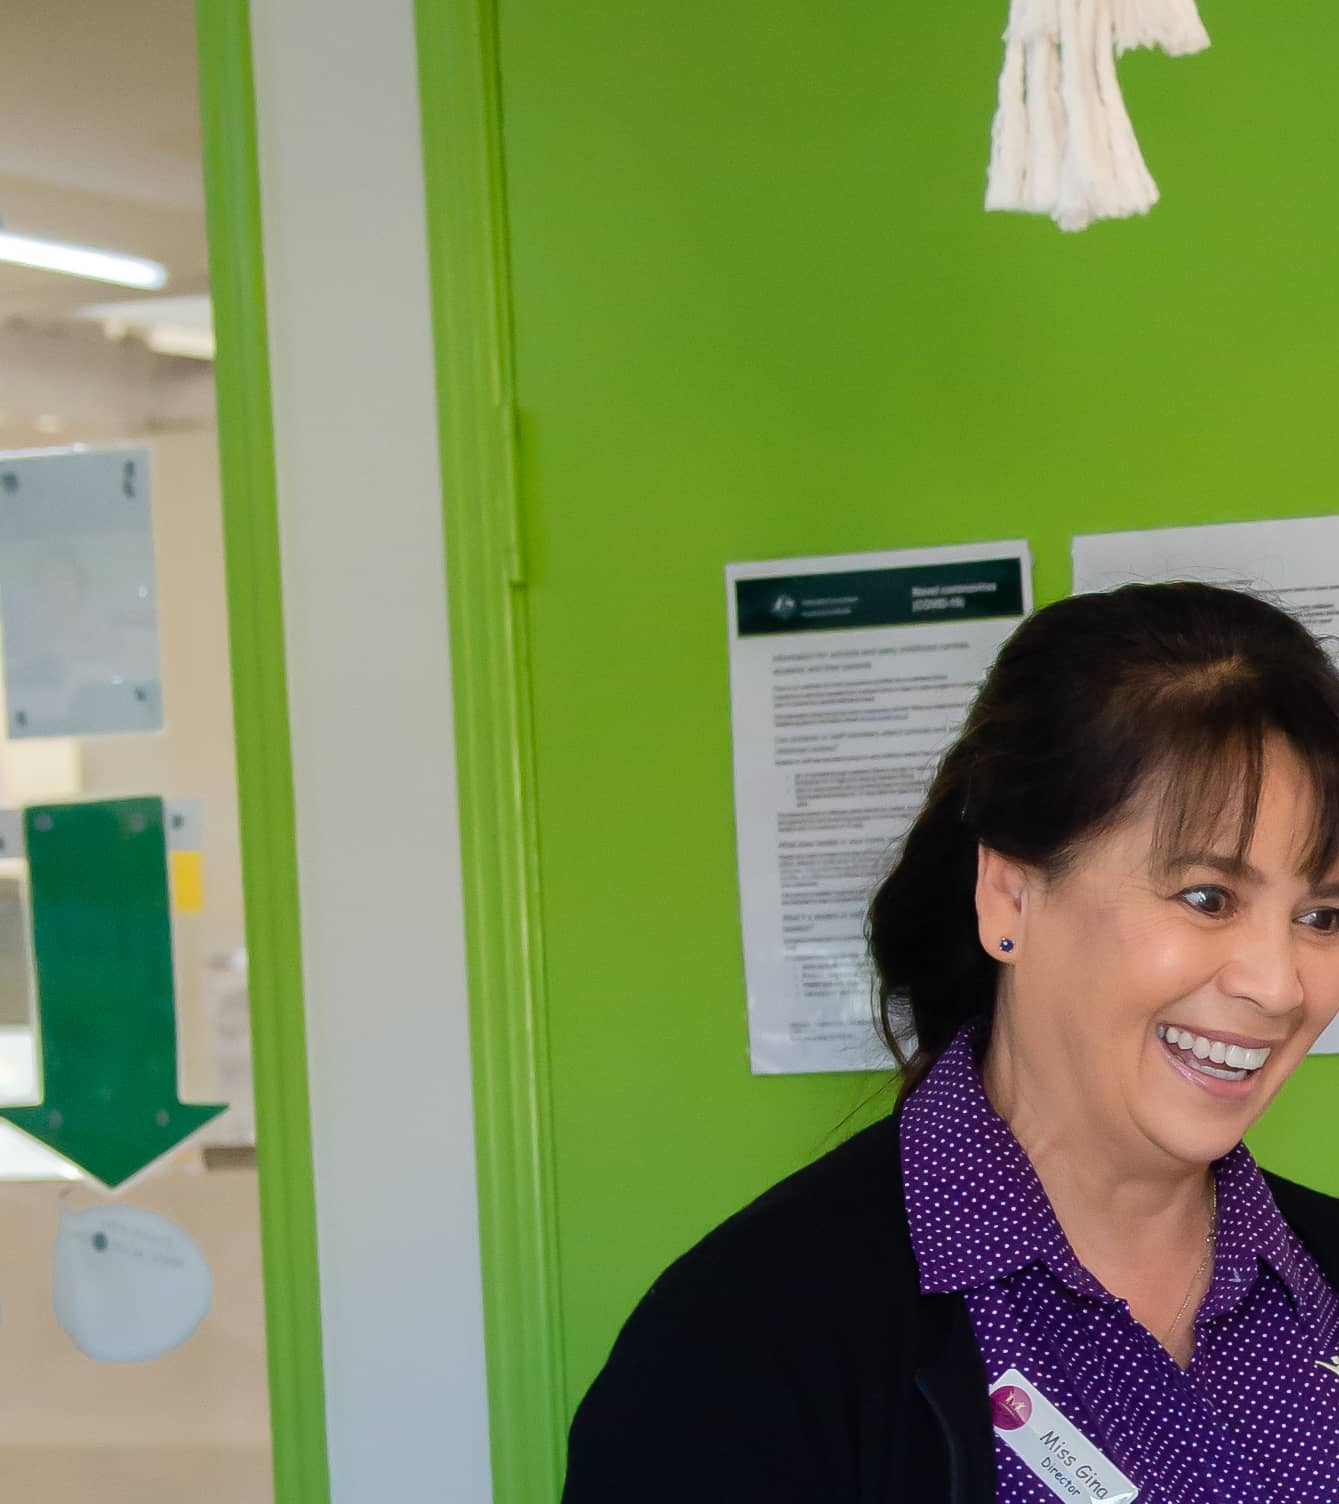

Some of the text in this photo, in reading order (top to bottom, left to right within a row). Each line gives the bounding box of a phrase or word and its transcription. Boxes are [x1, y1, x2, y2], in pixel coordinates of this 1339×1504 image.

[1040, 1430, 1109, 1500] Miss Gina
[1040, 1456, 1081, 1496] Director
